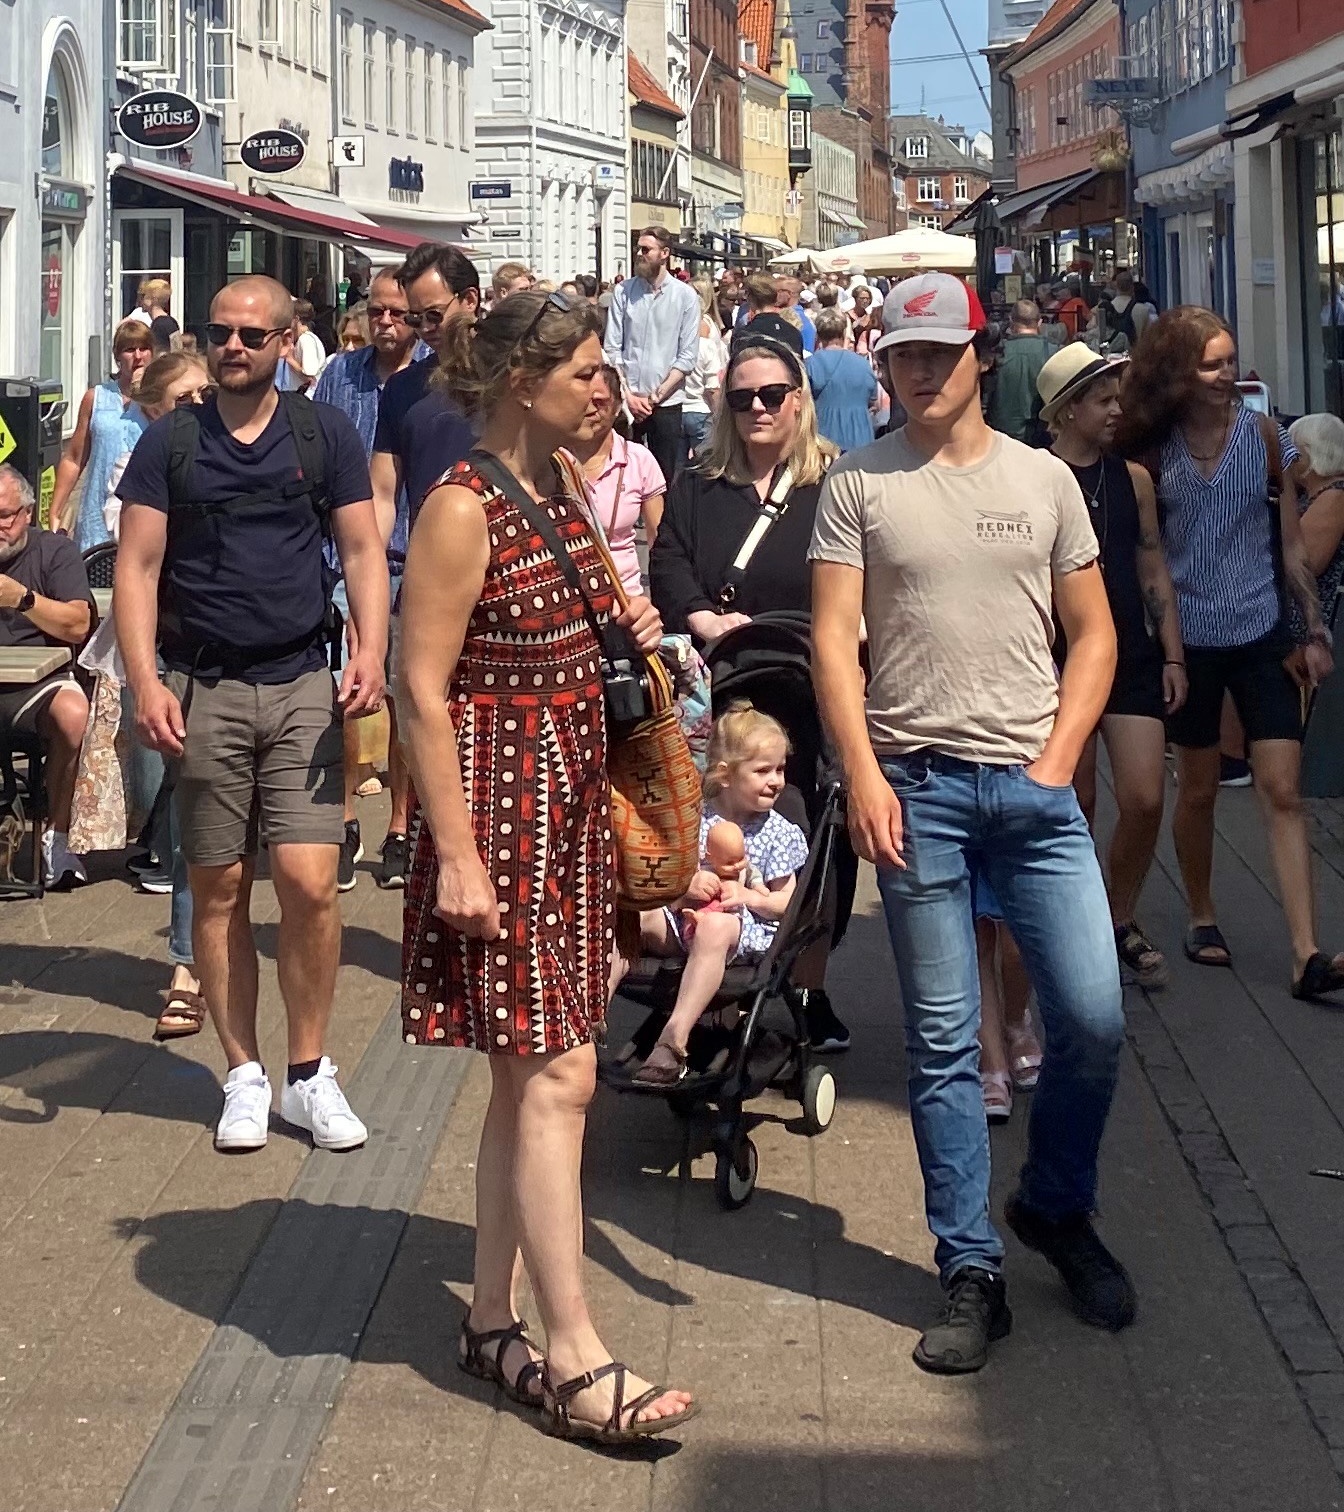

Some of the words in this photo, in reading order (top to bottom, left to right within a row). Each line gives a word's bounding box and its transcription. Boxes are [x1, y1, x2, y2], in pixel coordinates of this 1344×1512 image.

[126, 102, 170, 115] RIB
[143, 109, 194, 129] HOUSE
[246, 138, 280, 148] RIB
[259, 145, 299, 160] HOUSE
[976, 522, 1033, 535] REDNEX
